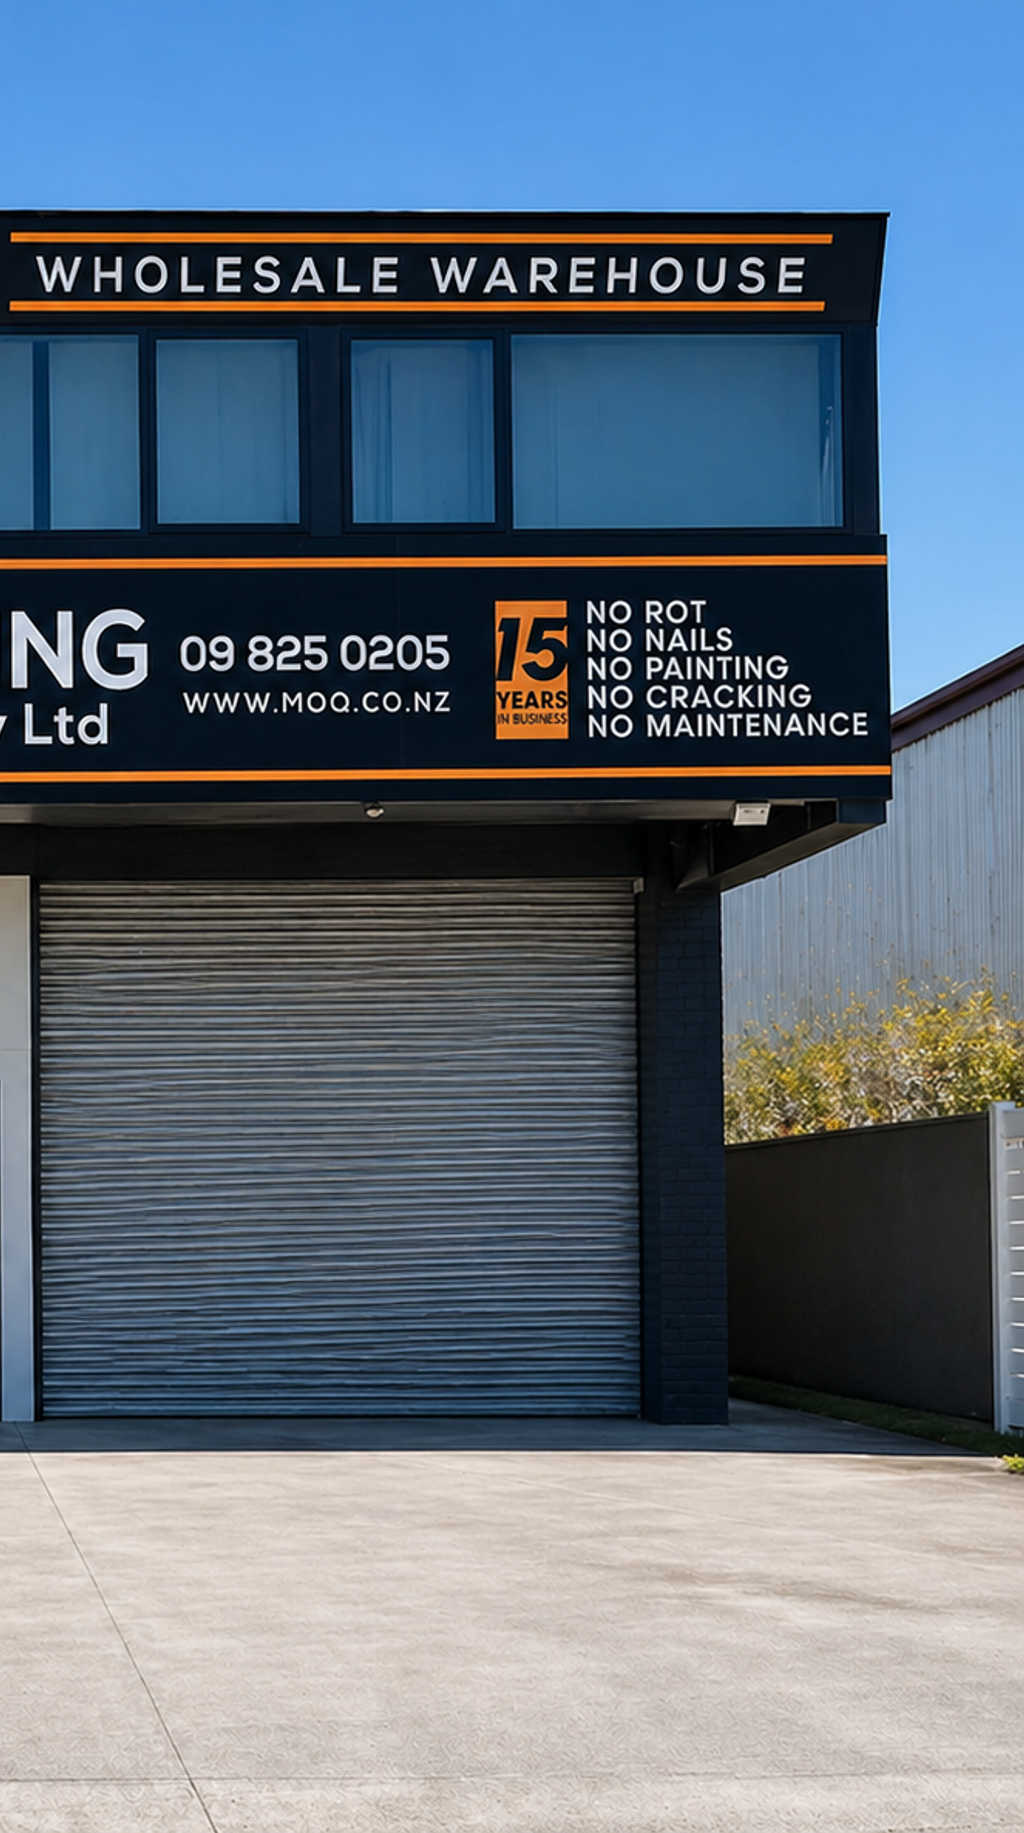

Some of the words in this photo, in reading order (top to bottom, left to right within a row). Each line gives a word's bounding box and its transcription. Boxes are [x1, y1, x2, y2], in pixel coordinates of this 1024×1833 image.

[35, 255, 399, 294] WHOLESALE
[430, 256, 805, 294] WAREHOUSE
[586, 600, 632, 624] NO
[645, 599, 707, 624] ROT
[180, 635, 235, 672] 09
[247, 635, 328, 672] 825
[340, 634, 450, 672] 0205
[496, 617, 567, 681] 15
[587, 628, 632, 653] NO
[645, 627, 733, 652] NAILS
[587, 656, 632, 681] NO
[646, 655, 789, 681] PAINTING
[182, 691, 451, 714] WWW.MOQ.CO.NZ
[496, 691, 567, 709] YEARS
[587, 684, 634, 710] NO
[646, 683, 812, 709] CRACKING
[24, 702, 108, 745] Ltd
[497, 713, 510, 724] IN
[512, 711, 567, 725] BUSINESS
[588, 713, 634, 738] NO
[646, 711, 869, 738] MAINTENANCE
